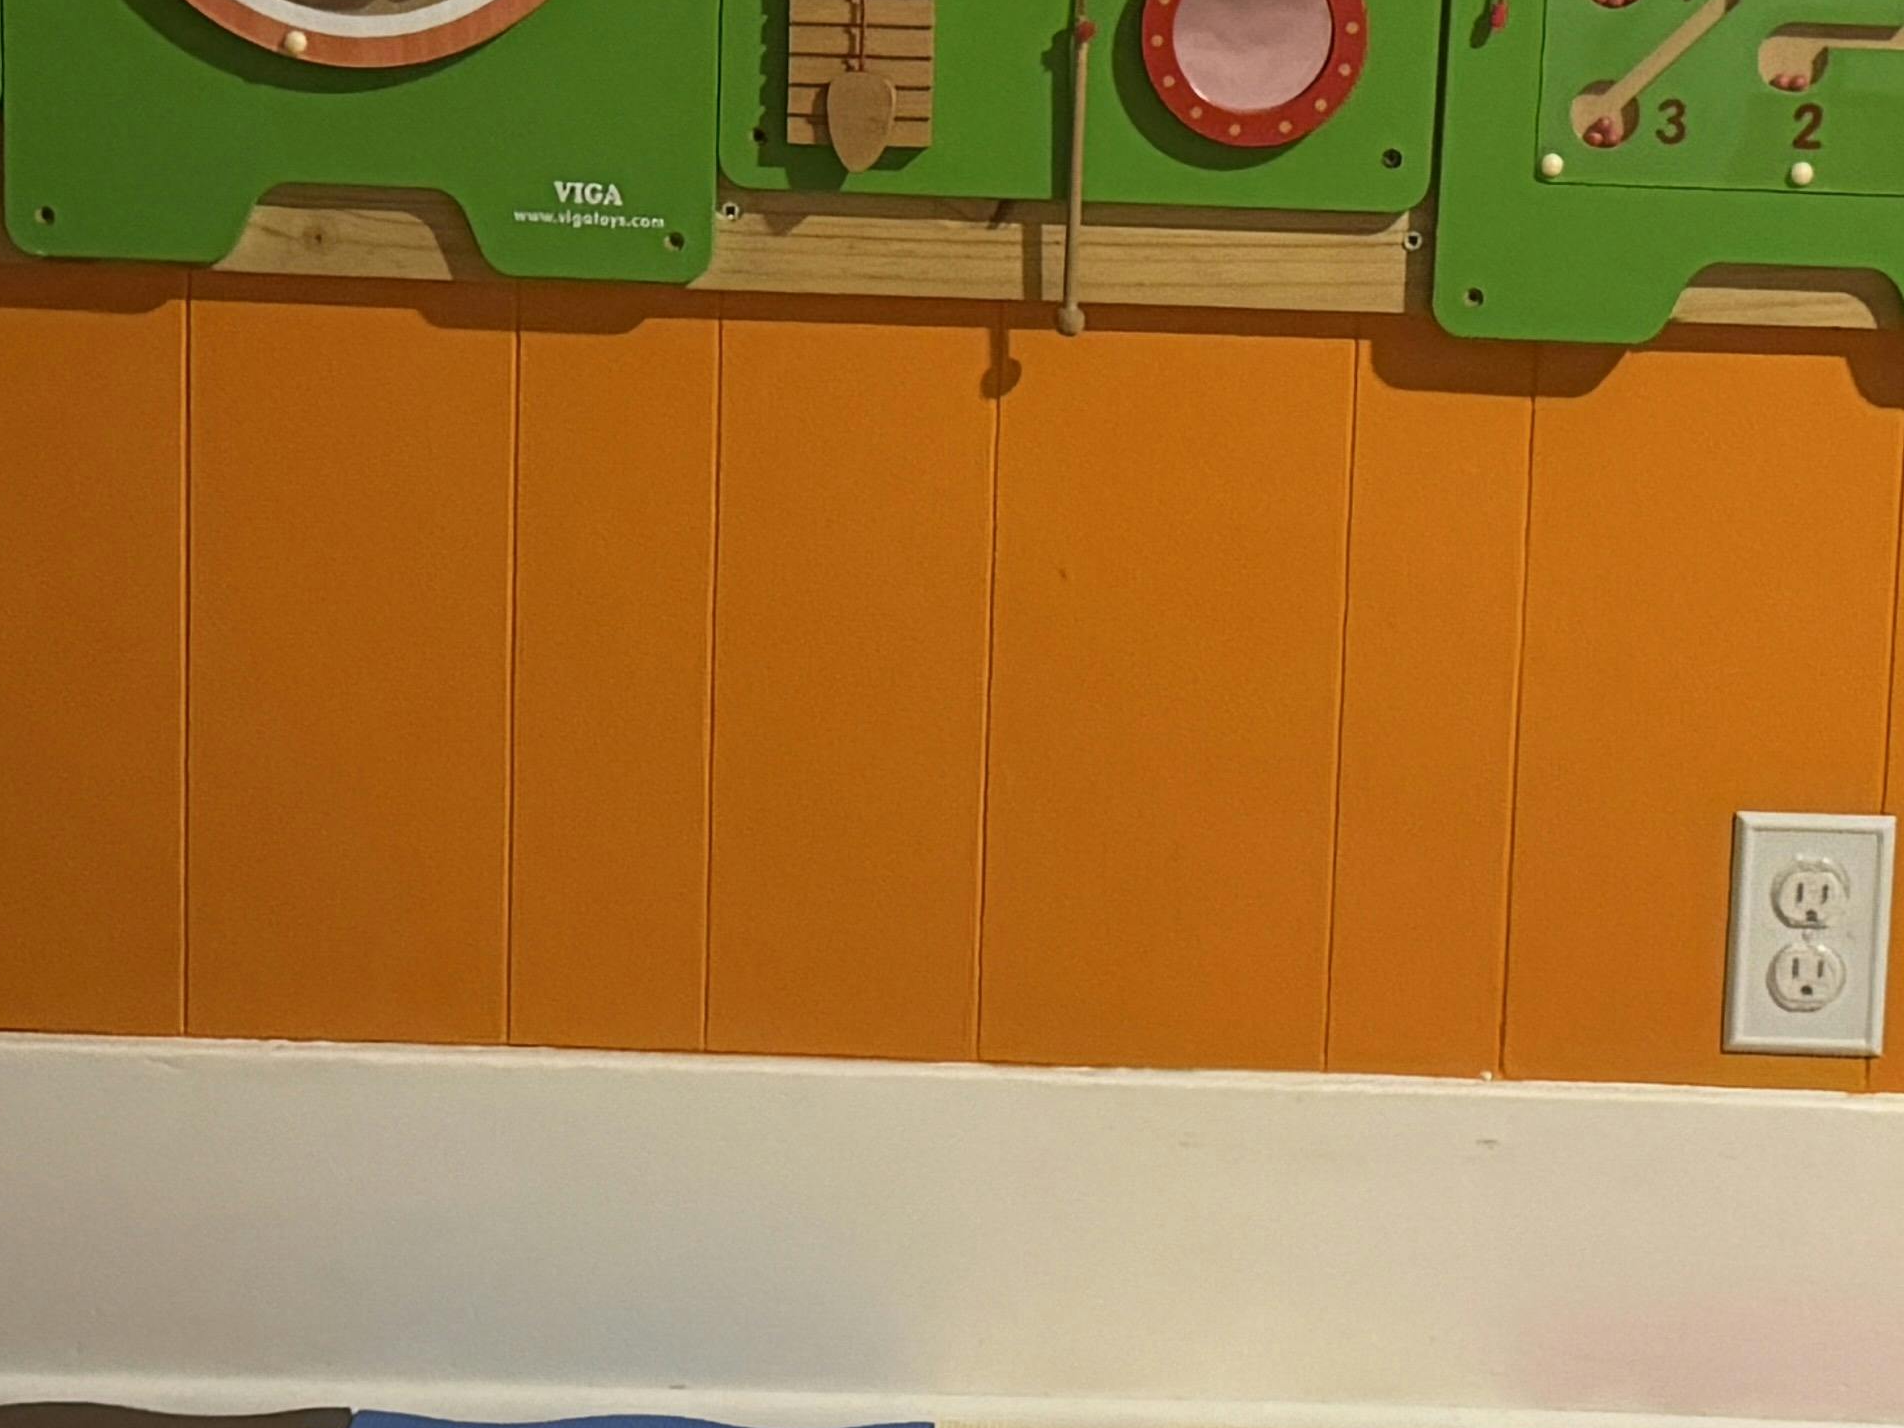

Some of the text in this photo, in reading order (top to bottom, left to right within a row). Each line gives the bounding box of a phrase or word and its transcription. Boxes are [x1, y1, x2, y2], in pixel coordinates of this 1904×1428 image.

[1655, 98, 1687, 145] 3
[1791, 103, 1823, 150] 2
[553, 181, 623, 206] VIGA
[513, 209, 665, 229] www.vigatoys.com
